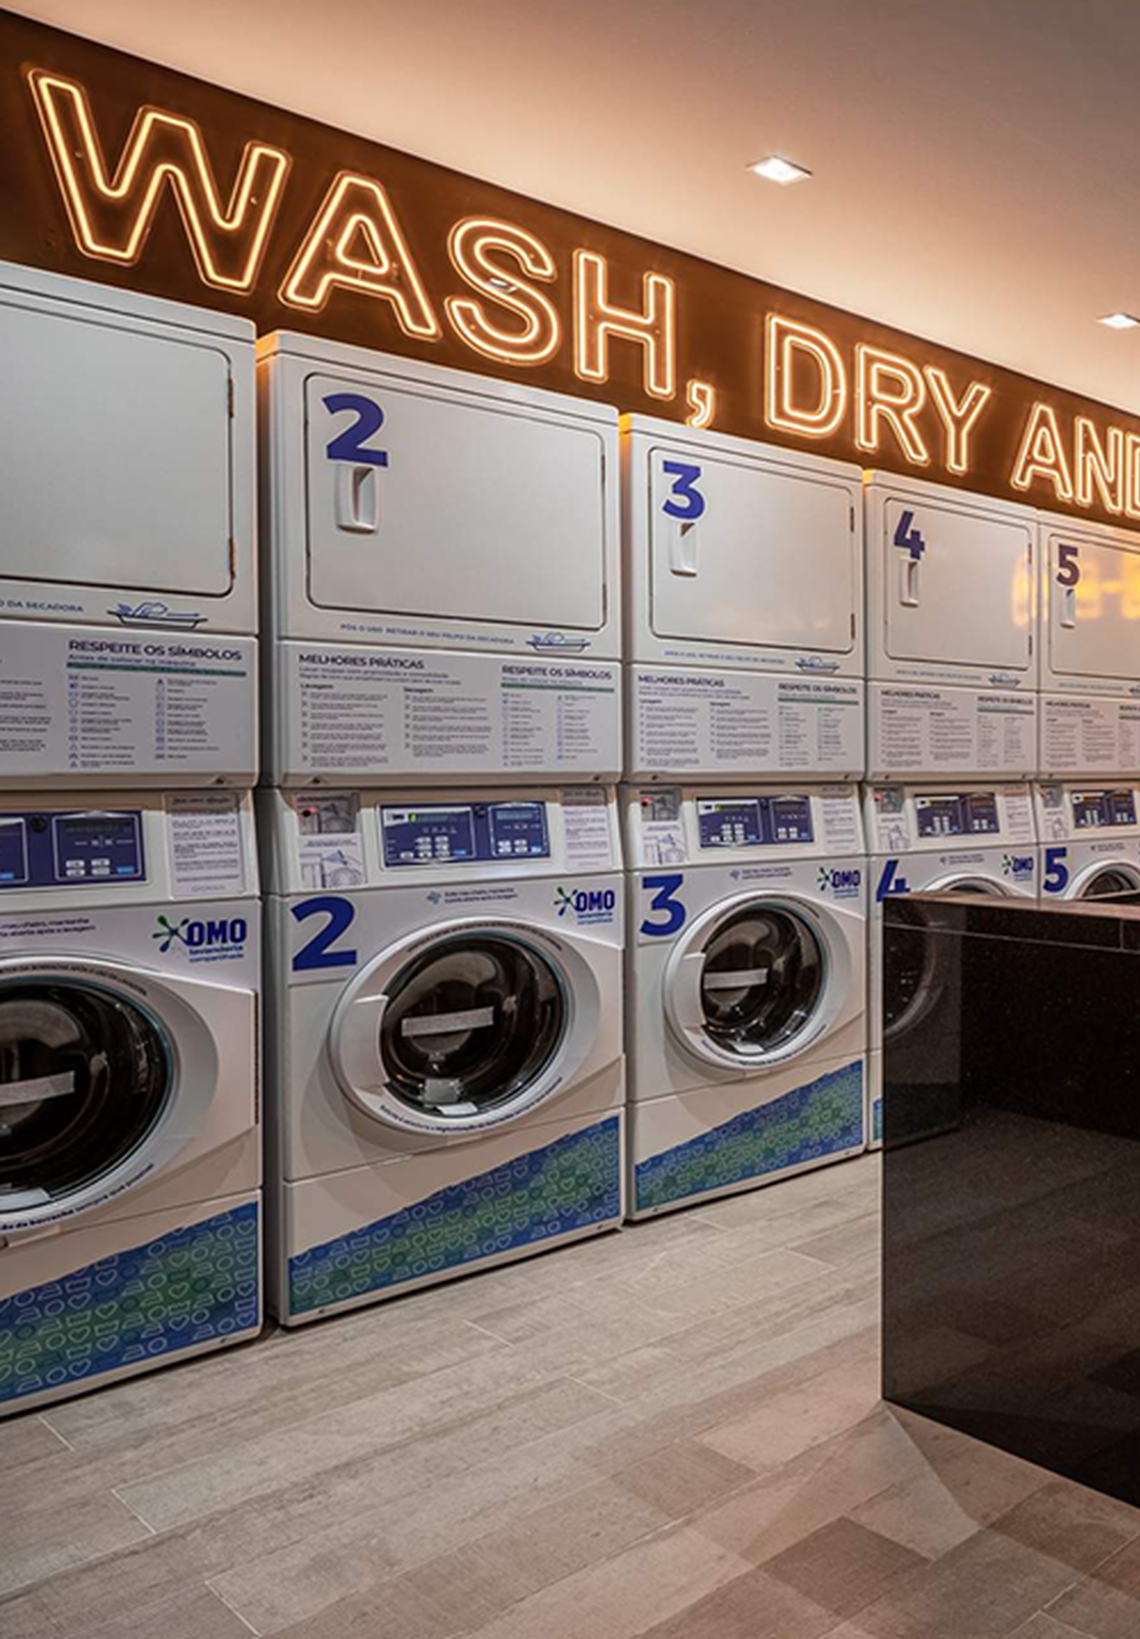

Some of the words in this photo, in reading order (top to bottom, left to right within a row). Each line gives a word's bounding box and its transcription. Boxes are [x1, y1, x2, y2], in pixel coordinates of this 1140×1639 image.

[28, 69, 713, 428] WASH,
[766, 313, 990, 473] DRY
[322, 393, 388, 467] 2
[661, 460, 706, 520] 3
[893, 510, 925, 561] 4
[1056, 544, 1080, 587] 5
[69, 639, 141, 656] RESPEITE
[144, 645, 165, 657] OS
[168, 645, 243, 661] SÍMBOLOS
[299, 654, 368, 667] MELHORES
[370, 656, 425, 670] PRÁTICAS
[876, 859, 911, 903] 4
[1043, 846, 1068, 893] 5
[576, 889, 615, 912] OMO
[640, 874, 687, 936] 3
[186, 918, 247, 947] OMO
[290, 896, 357, 972] 2
